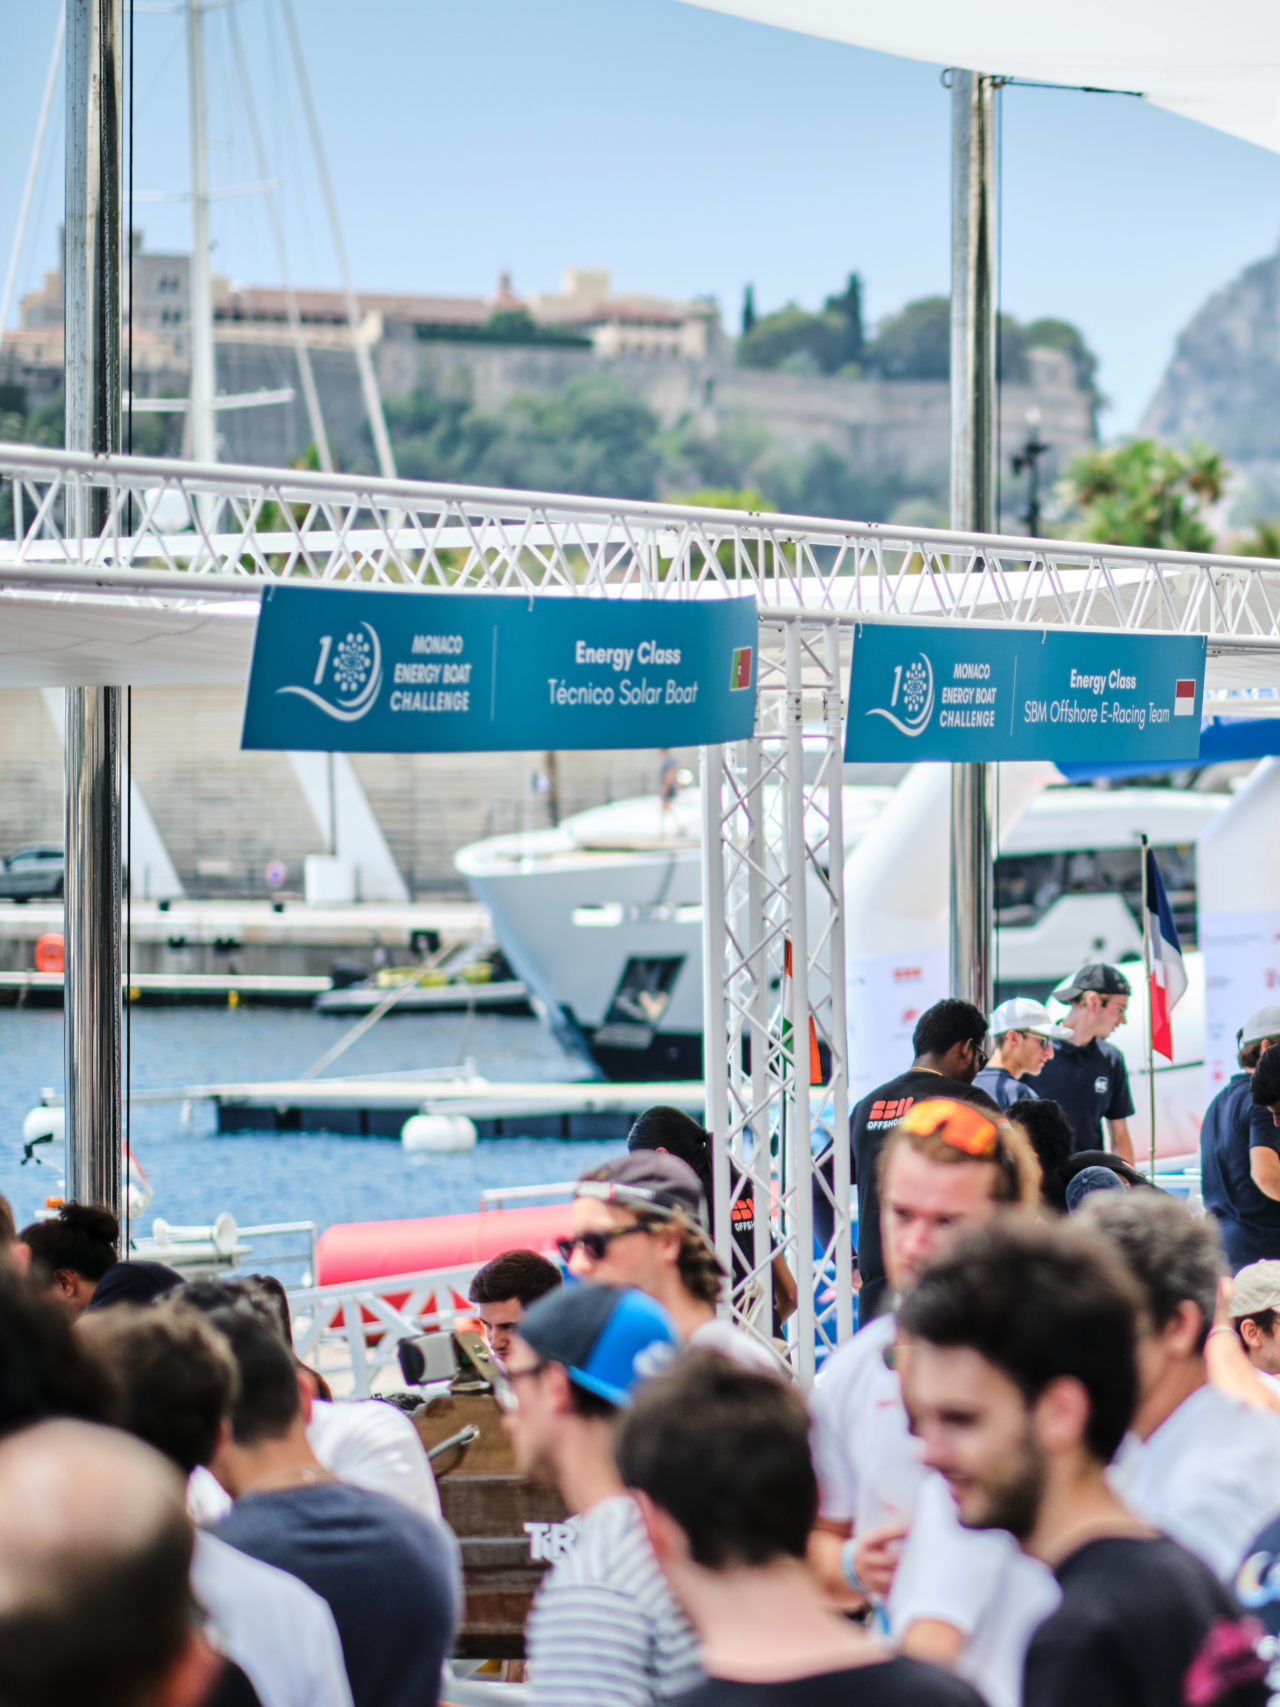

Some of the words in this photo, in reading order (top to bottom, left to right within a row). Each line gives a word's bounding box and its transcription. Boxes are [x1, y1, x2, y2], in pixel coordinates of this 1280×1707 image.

[411, 634, 464, 655] MONACO
[574, 639, 634, 671] Energy
[636, 640, 682, 665] Class
[393, 662, 441, 685] ENERGY
[442, 662, 473, 685] BOAT
[952, 663, 991, 680] MONACO
[1070, 668, 1107, 695] Energy
[1108, 669, 1137, 690] Class
[389, 690, 471, 713] CHALLENGE
[547, 678, 615, 706] Técnico
[619, 678, 663, 706] Solar
[664, 679, 699, 705] Boat
[941, 686, 974, 705] ENERGY
[975, 686, 998, 705] BOAT
[939, 709, 996, 728] CHALLENGE
[1023, 700, 1048, 724] SBM
[1049, 699, 1098, 724] Offshore
[1100, 701, 1147, 730] E-Racing
[1148, 702, 1171, 724] Team
